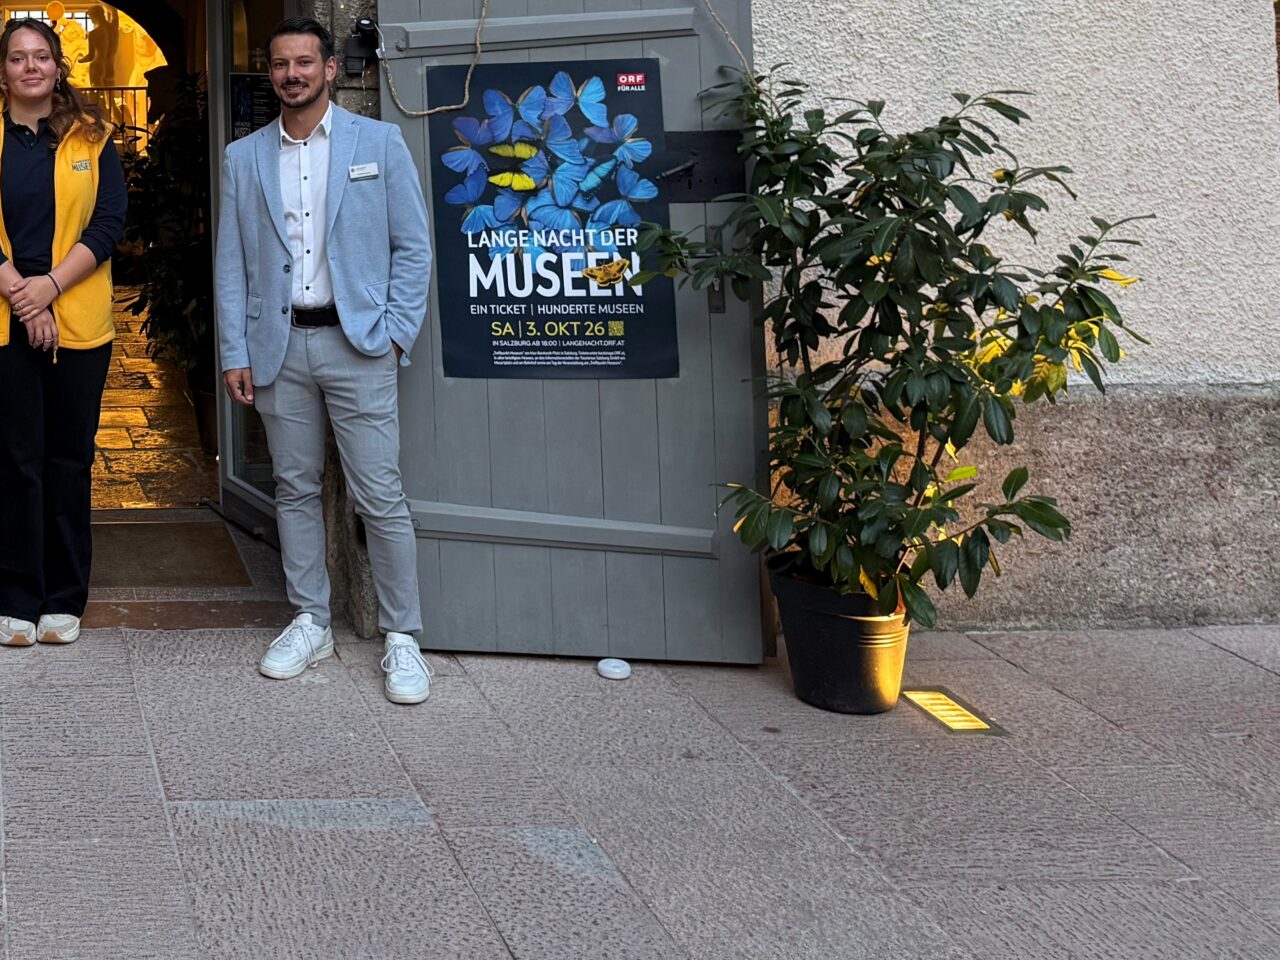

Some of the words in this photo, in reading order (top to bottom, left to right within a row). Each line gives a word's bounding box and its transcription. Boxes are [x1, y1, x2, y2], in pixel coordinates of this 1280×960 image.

[619, 75, 643, 83] ORF
[467, 230, 529, 248] LANGE
[534, 228, 597, 248] NACHT
[601, 228, 638, 246] DER
[469, 251, 643, 298] MUSEEN
[470, 305, 488, 315] EIN
[489, 304, 526, 315] TICKET
[538, 304, 596, 315] HUNDERTE
[598, 304, 644, 314] MUSEEN
[491, 321, 514, 336] SA
[526, 321, 541, 336] 3.
[544, 321, 581, 336] OKT
[584, 321, 605, 336] 26
